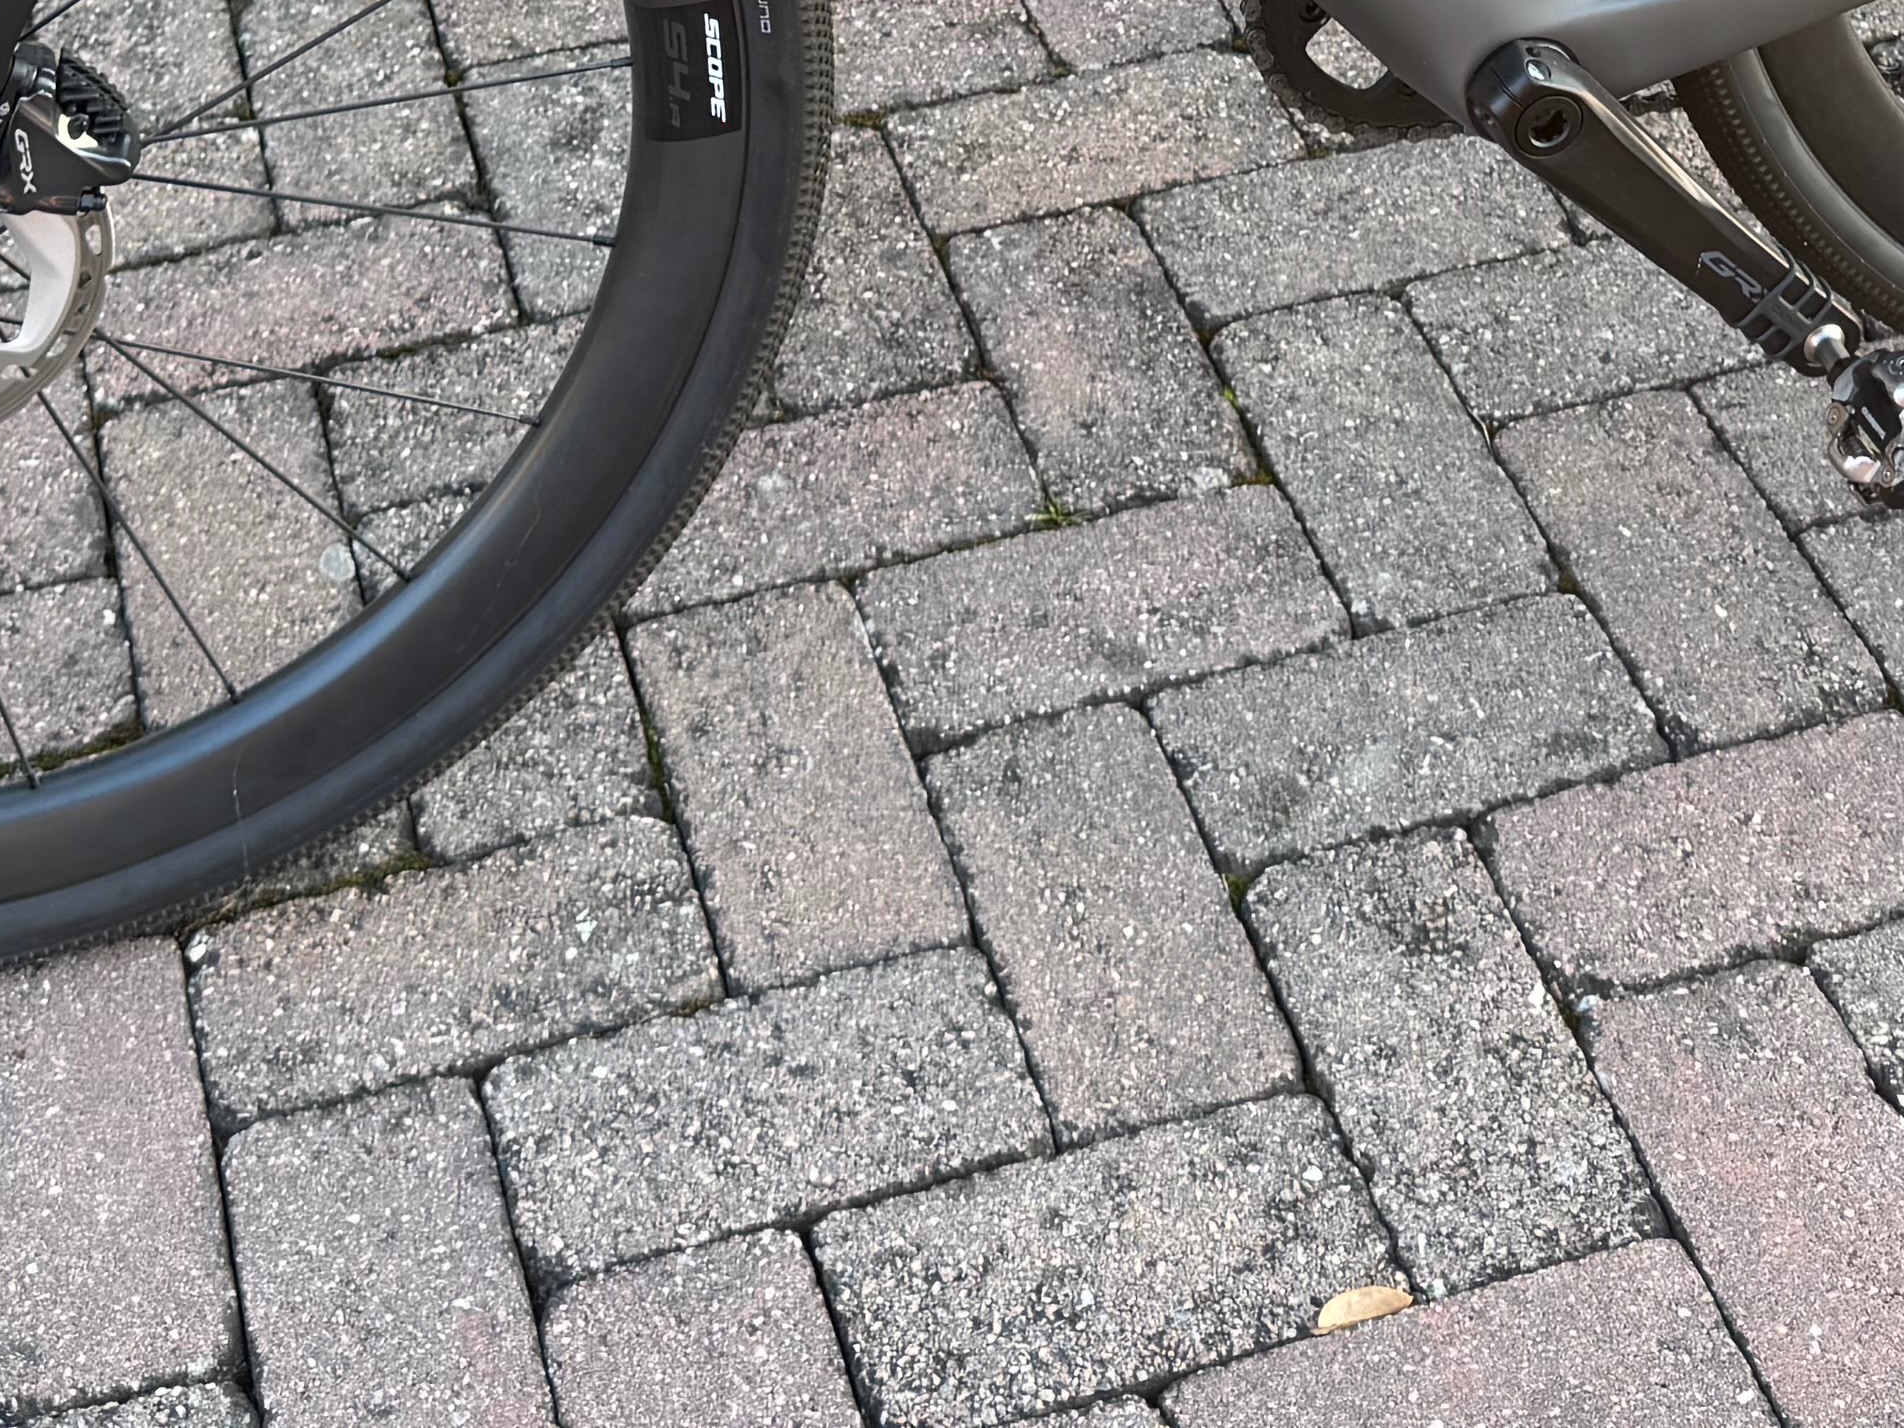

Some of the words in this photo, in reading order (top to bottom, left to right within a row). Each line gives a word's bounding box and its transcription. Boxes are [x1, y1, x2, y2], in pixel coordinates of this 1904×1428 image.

[703, 12, 727, 123] SCOPE
[14, 128, 37, 194] GRX
[1700, 250, 1768, 304] GR
